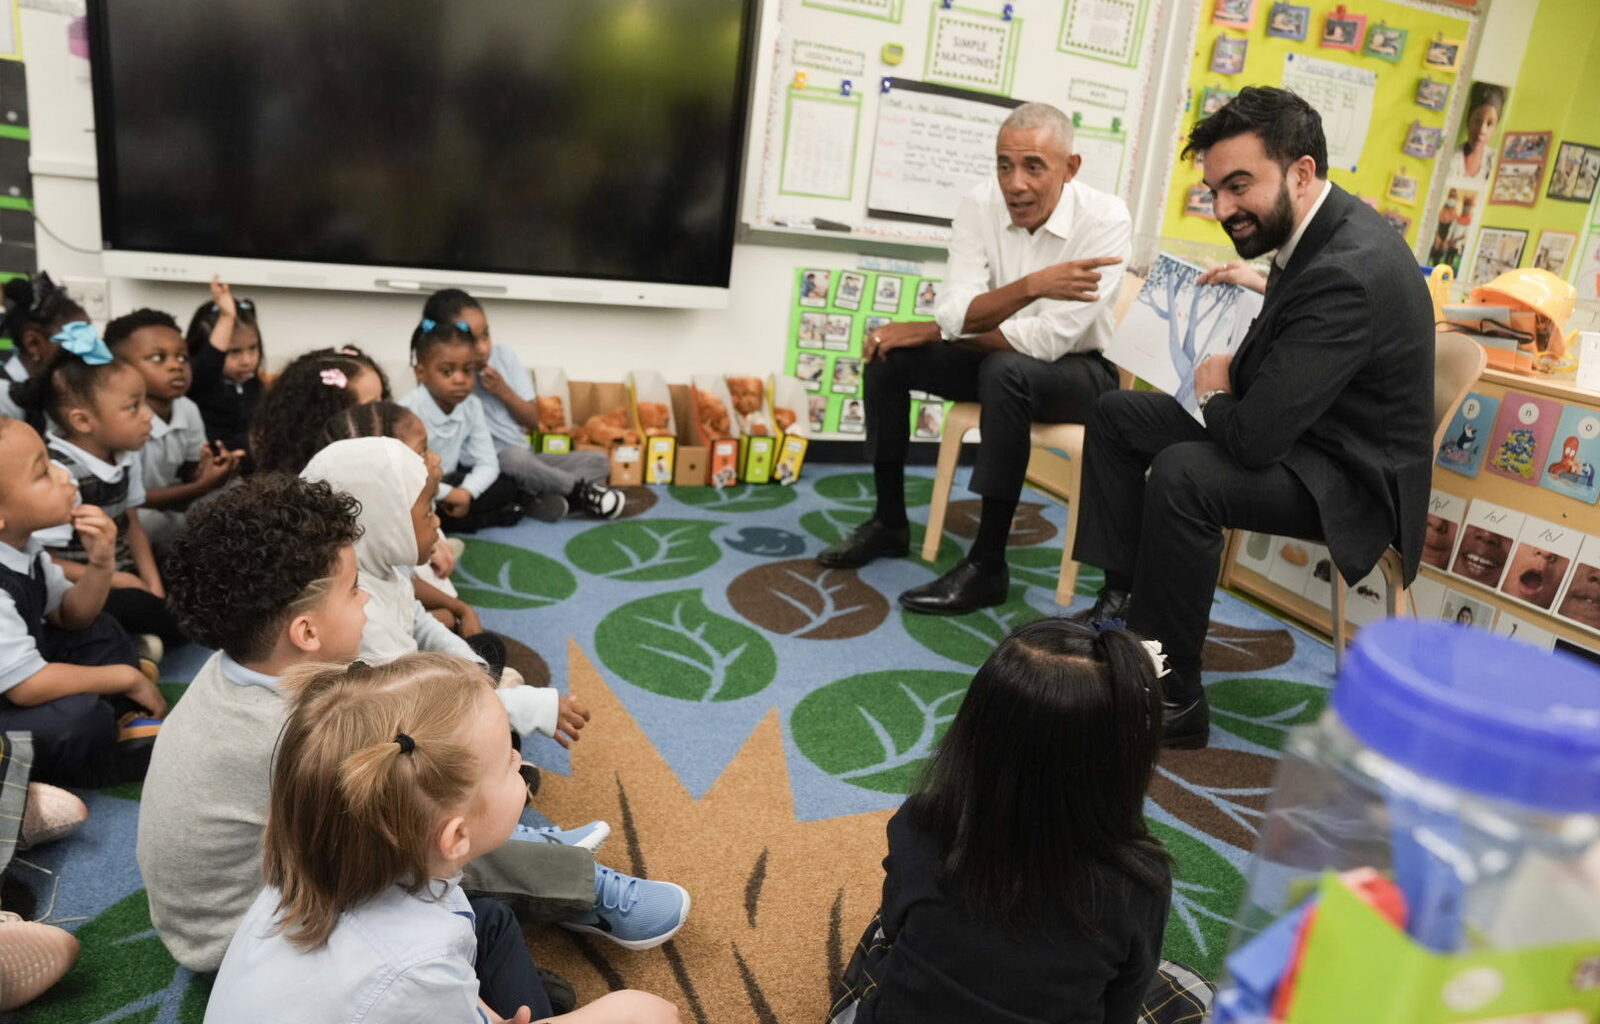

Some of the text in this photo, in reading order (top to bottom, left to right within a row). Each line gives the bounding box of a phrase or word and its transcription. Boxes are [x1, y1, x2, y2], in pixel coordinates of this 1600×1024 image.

[953, 36, 987, 52] SIMPLE
[942, 51, 994, 69] MACHINES
[1467, 403, 1475, 415] p
[1525, 409, 1532, 417] n
[1586, 424, 1593, 432] o
[1484, 510, 1507, 524] /n/
